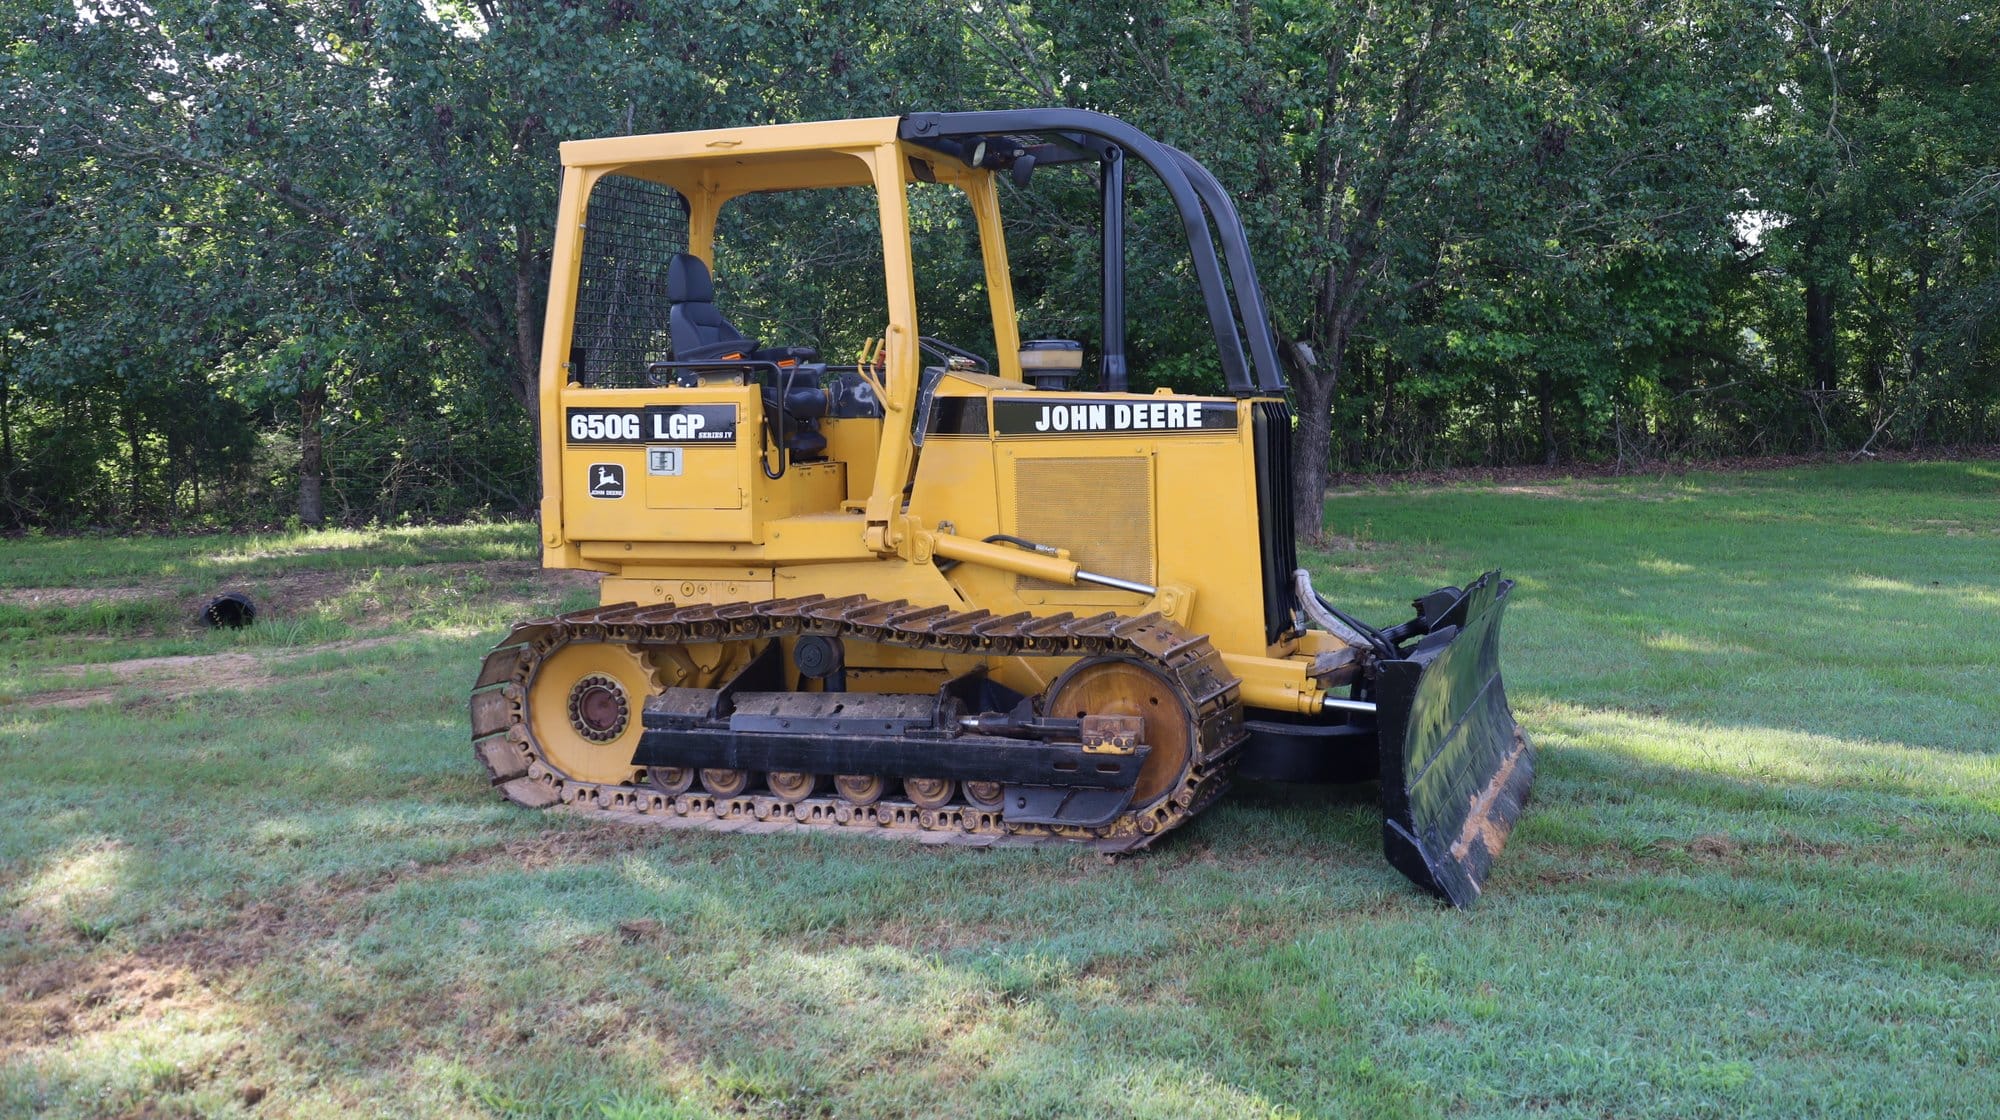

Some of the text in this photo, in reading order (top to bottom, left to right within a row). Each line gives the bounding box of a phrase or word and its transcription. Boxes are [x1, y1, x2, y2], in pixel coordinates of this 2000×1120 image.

[570, 414, 705, 439] 650G LGP
[1035, 402, 1202, 431] JOHN DEERE
[698, 431, 724, 439] SERIES
